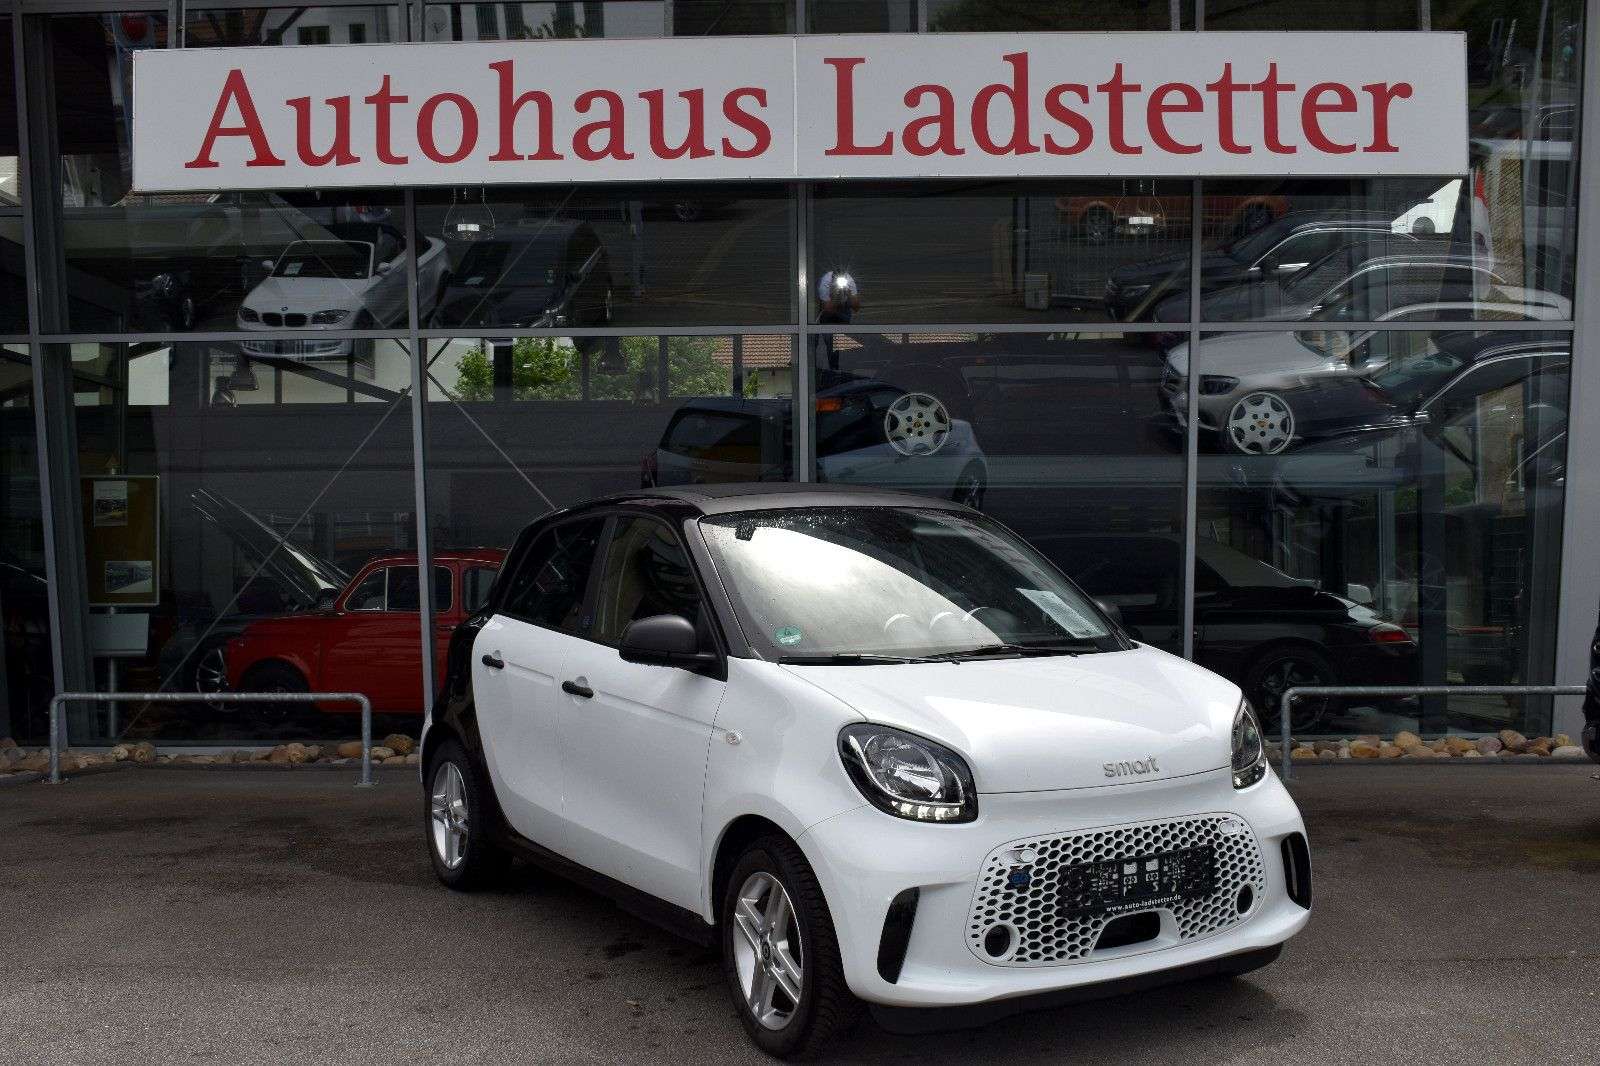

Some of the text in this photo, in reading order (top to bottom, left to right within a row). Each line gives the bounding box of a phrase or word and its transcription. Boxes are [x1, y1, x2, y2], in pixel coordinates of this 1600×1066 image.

[184, 52, 1413, 168] Autohaus Ladstetter
[1103, 757, 1160, 777] smart
[1106, 894, 1182, 912] www.auto-ladstetter.de
